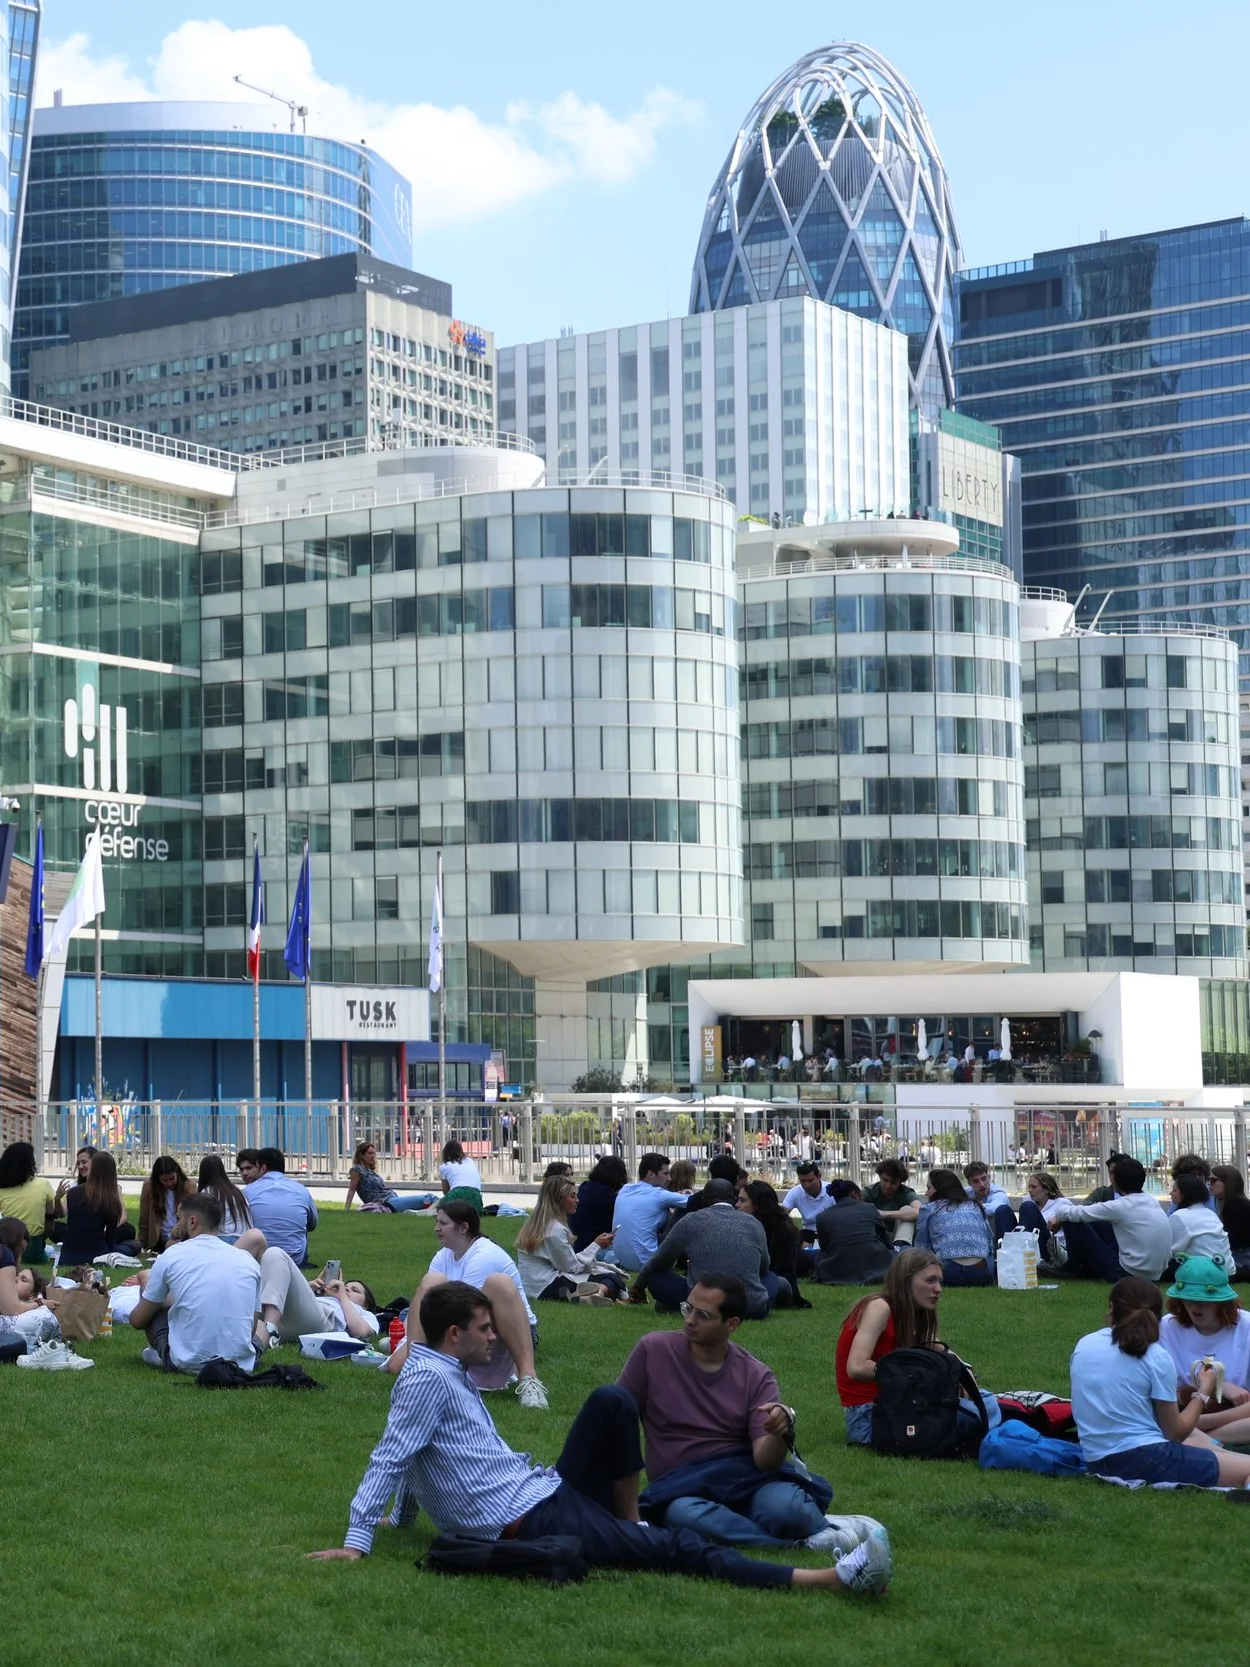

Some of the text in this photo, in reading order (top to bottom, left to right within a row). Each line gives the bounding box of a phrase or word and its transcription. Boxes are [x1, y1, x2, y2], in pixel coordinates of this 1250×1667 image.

[942, 465, 998, 513] LIBERTY
[84, 800, 142, 827] cœur
[346, 999, 397, 1022] TUSK
[704, 1028, 715, 1072] ECLIPSE
